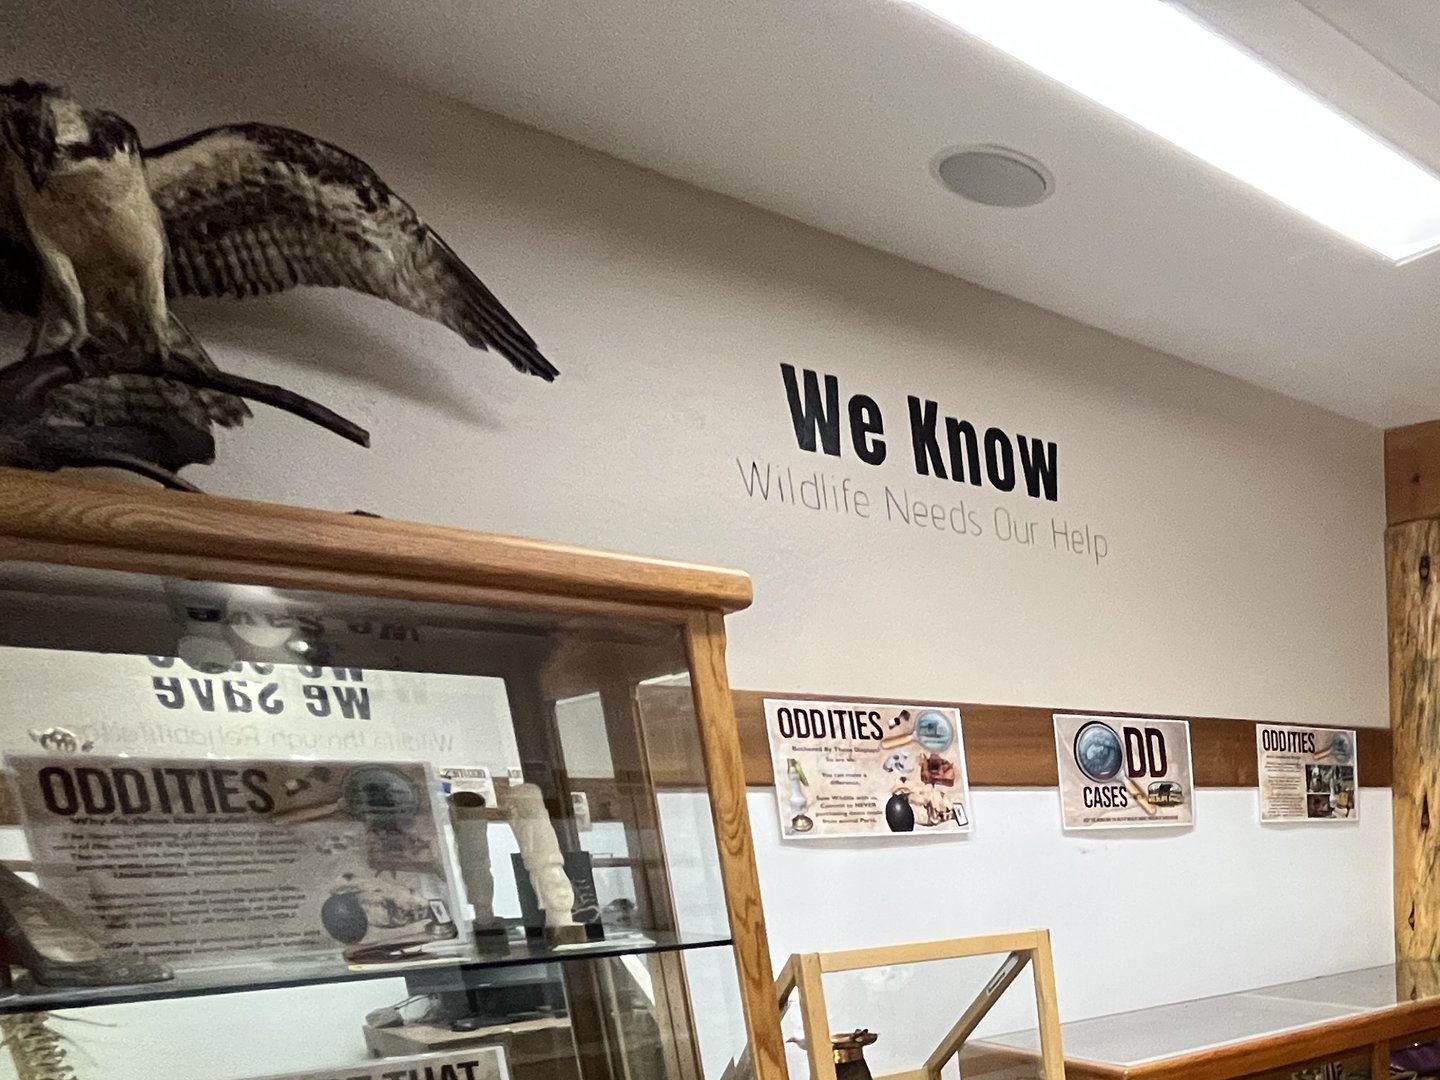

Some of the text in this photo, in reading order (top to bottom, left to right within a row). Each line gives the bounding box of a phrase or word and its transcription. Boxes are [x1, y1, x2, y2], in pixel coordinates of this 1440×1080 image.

[780, 362, 1058, 502] We Know
[736, 457, 1108, 565] Wildlife Needs Our Help
[776, 707, 883, 740] ODDITIES
[1262, 729, 1316, 753] ODDITIES
[38, 766, 276, 817] ODDITIES
[1083, 786, 1128, 808] CASES
